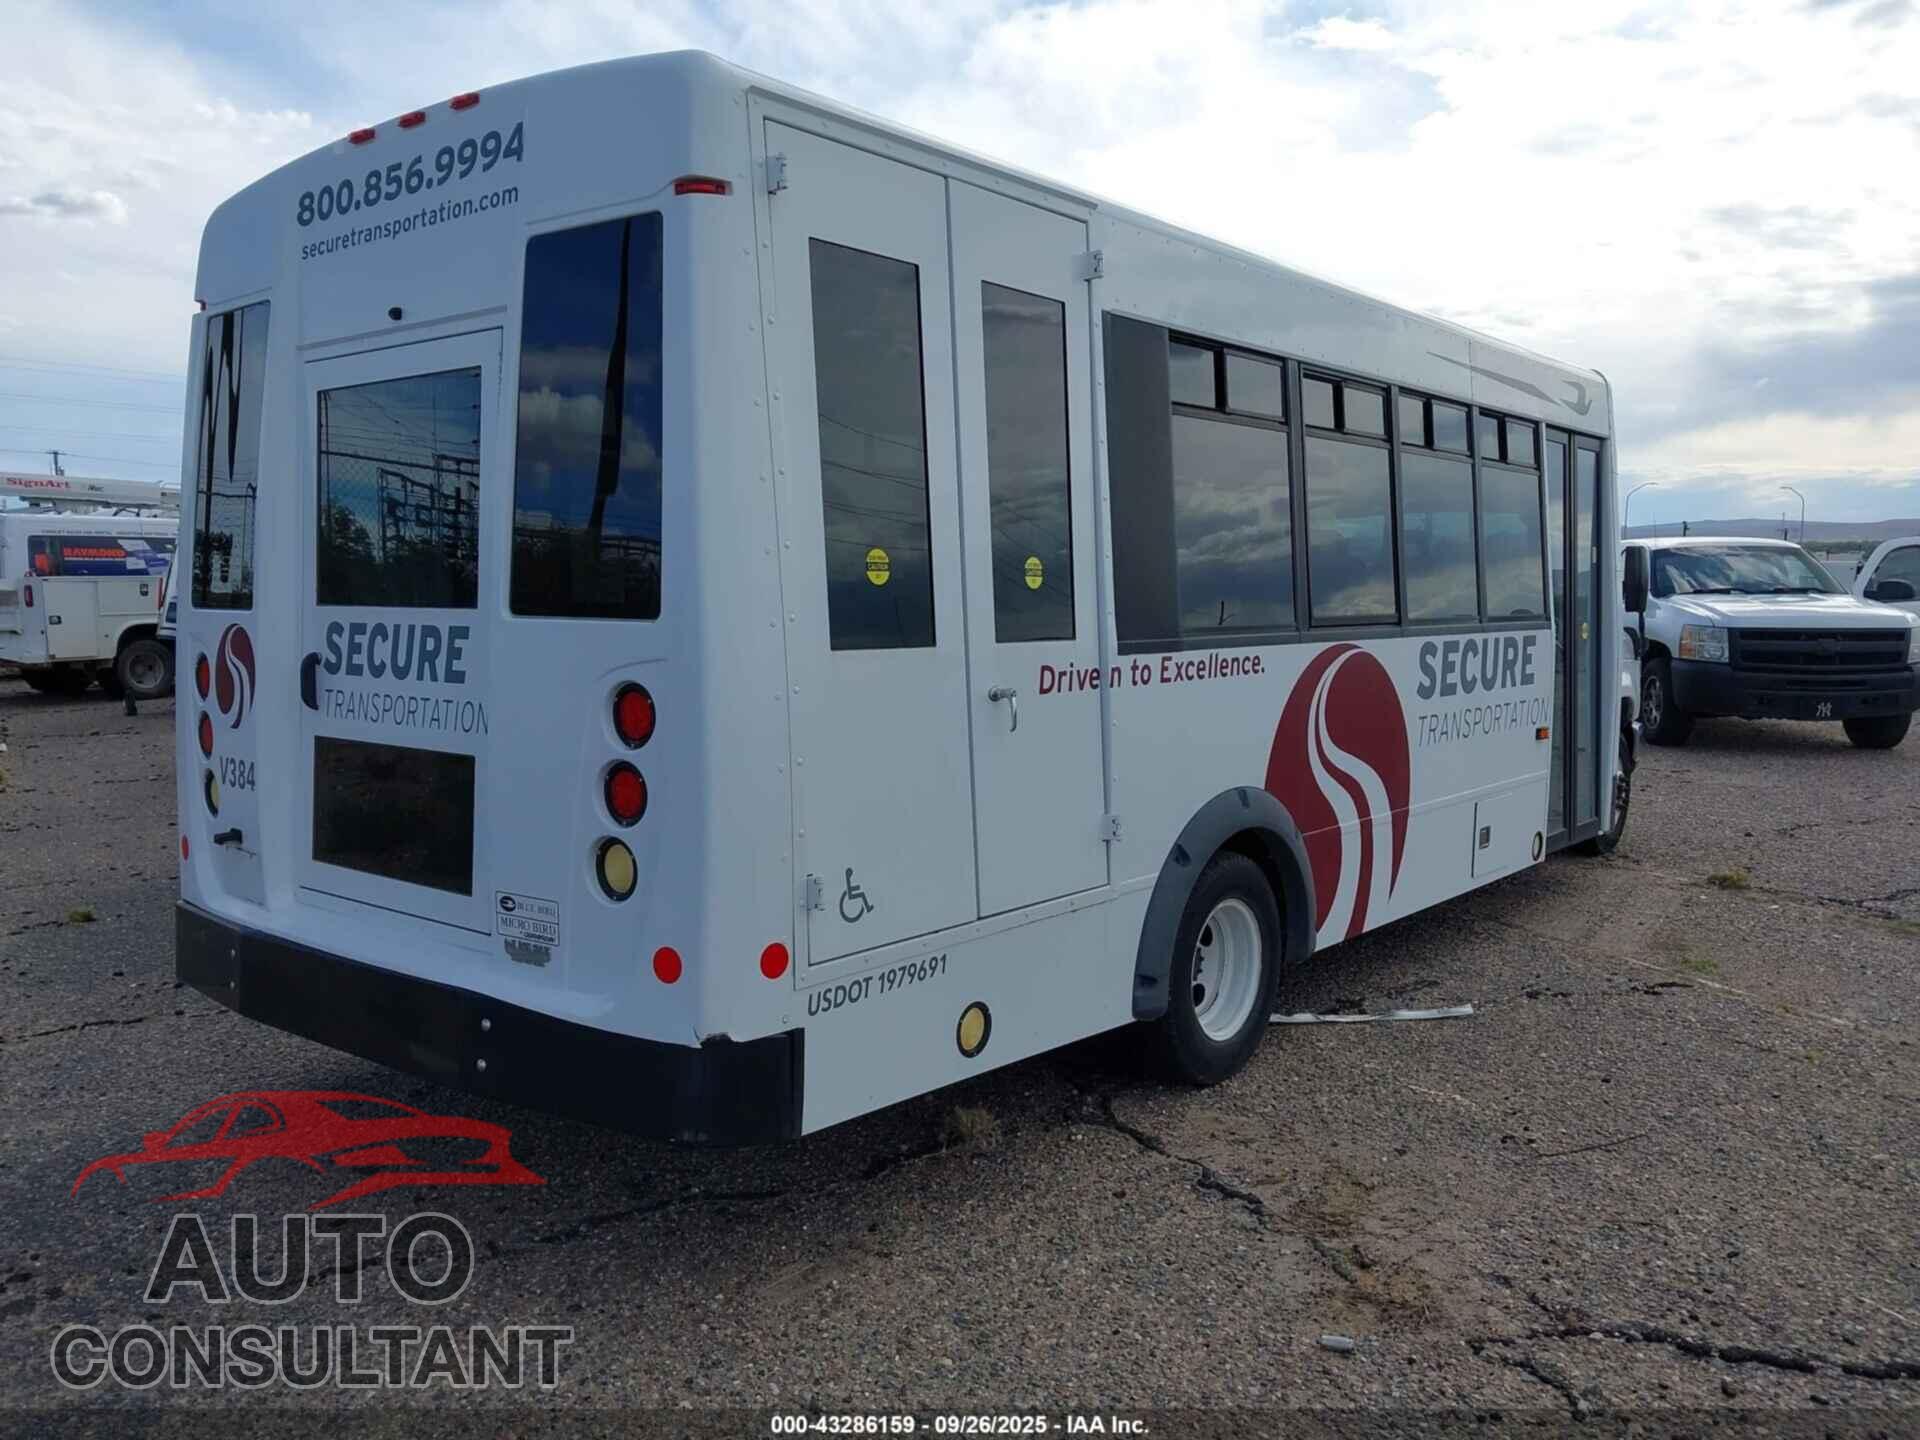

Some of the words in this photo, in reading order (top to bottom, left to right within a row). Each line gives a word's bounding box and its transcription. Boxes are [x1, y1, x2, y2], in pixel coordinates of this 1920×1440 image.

[296, 121, 524, 227] 800.856.9994
[301, 186, 519, 261] securetransportation.com
[6, 476, 72, 490] SignArt
[323, 621, 470, 684] SECURE
[1039, 661, 1121, 695] Driven
[1130, 658, 1151, 687] to
[1160, 652, 1265, 684] Excellence.
[1417, 635, 1537, 700] SECURE
[325, 688, 489, 735] TRANSPORTATION
[1417, 697, 1550, 747] TRANSPORTATION
[219, 756, 256, 792] V384
[807, 976, 872, 1017] USDOT
[878, 953, 947, 994] 1979691
